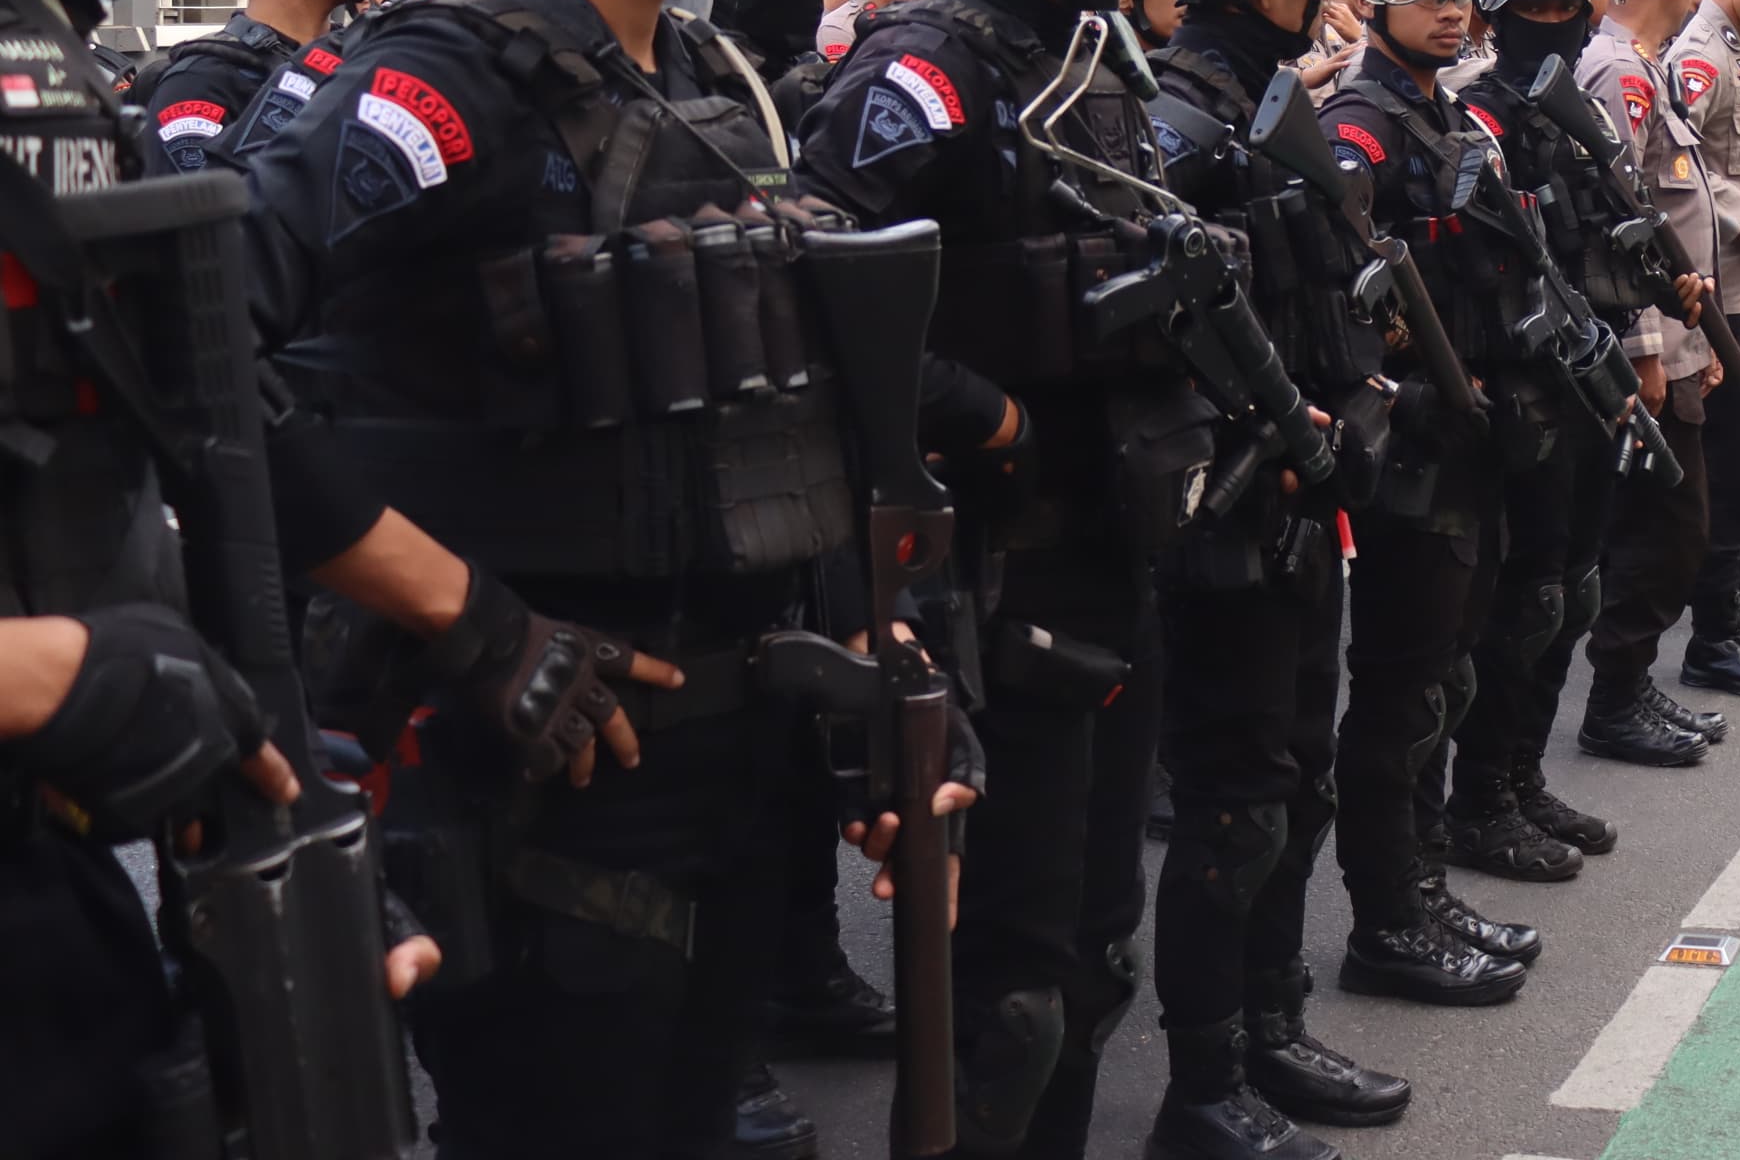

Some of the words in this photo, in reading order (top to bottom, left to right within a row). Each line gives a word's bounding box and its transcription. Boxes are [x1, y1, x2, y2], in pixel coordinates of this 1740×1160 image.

[826, 46, 849, 54] PELO
[892, 66, 947, 126] PENYELAM
[904, 58, 963, 121] PELOPOR
[161, 103, 220, 123] PELOPOR
[163, 120, 217, 138] PENYELAM
[380, 75, 466, 160] PELOPOR
[368, 102, 442, 181] PENYELAM
[1343, 128, 1381, 159] PELOPOR
